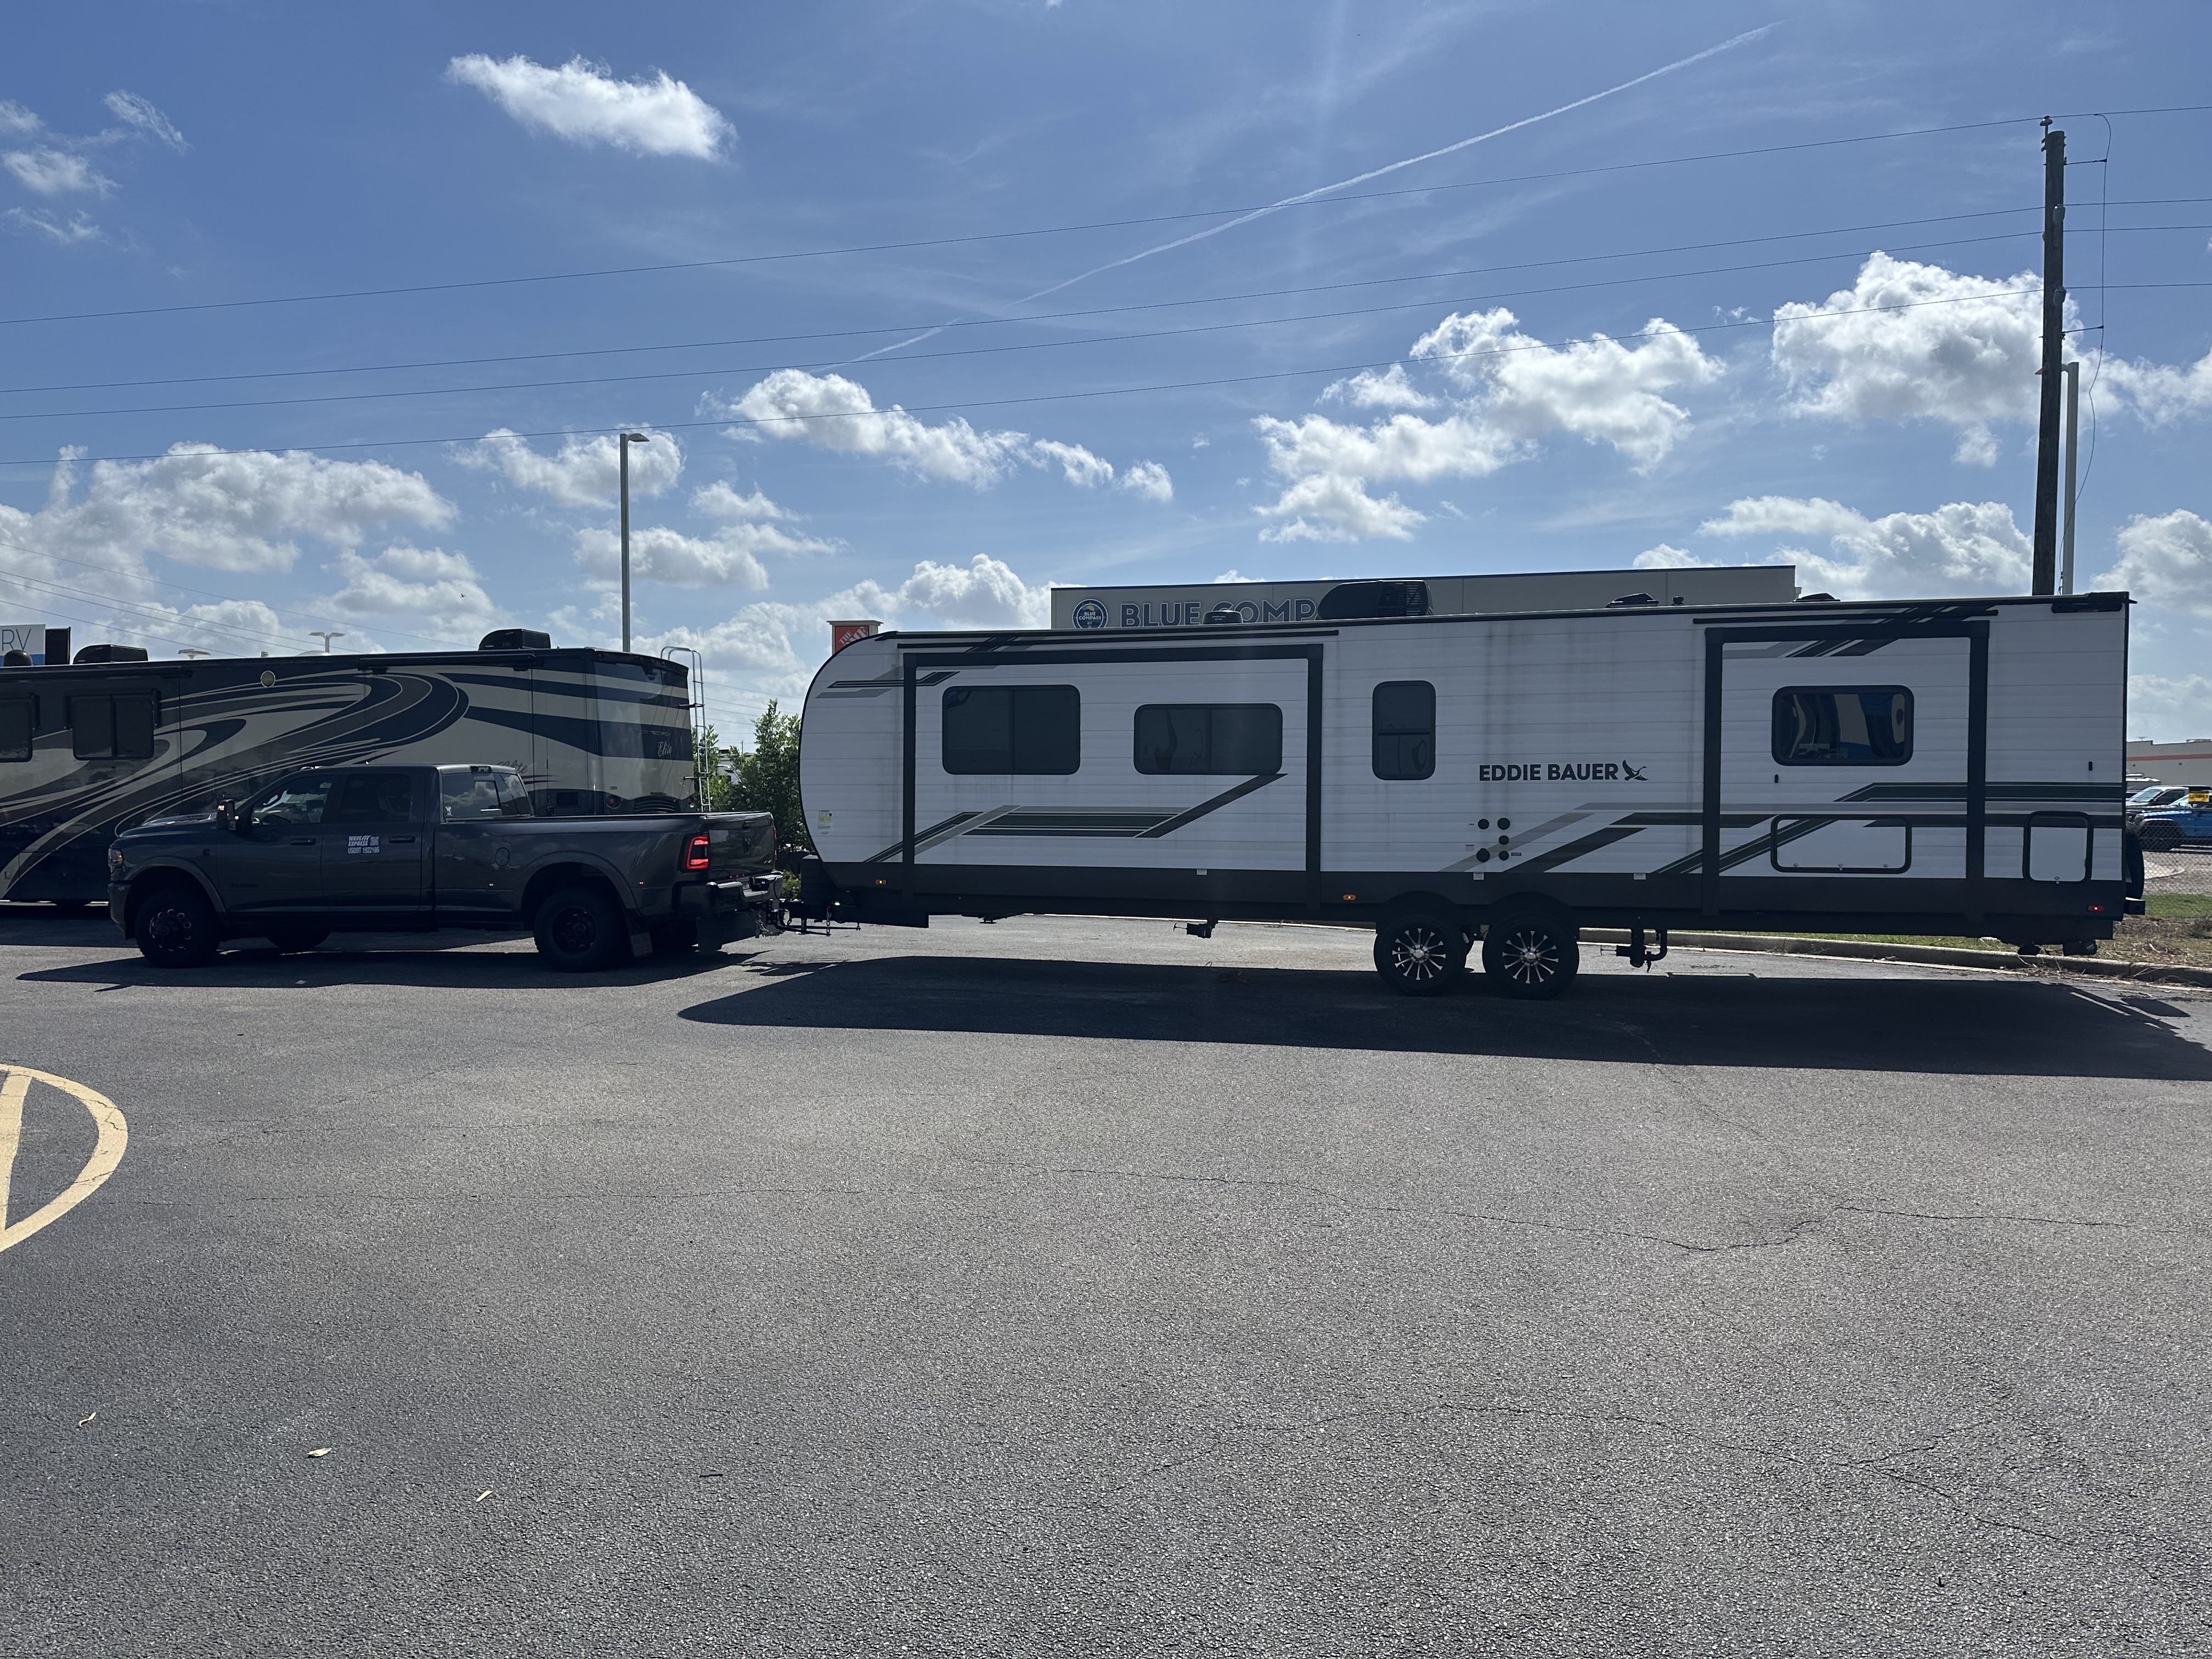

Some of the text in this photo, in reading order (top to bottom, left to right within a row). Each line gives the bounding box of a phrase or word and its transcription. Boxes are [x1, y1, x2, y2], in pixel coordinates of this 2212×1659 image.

[1120, 599, 1318, 628] BLUE OMP
[2, 628, 31, 652] RV
[658, 741, 672, 757] Elite
[1479, 763, 1619, 781] EDDIE BAUER
